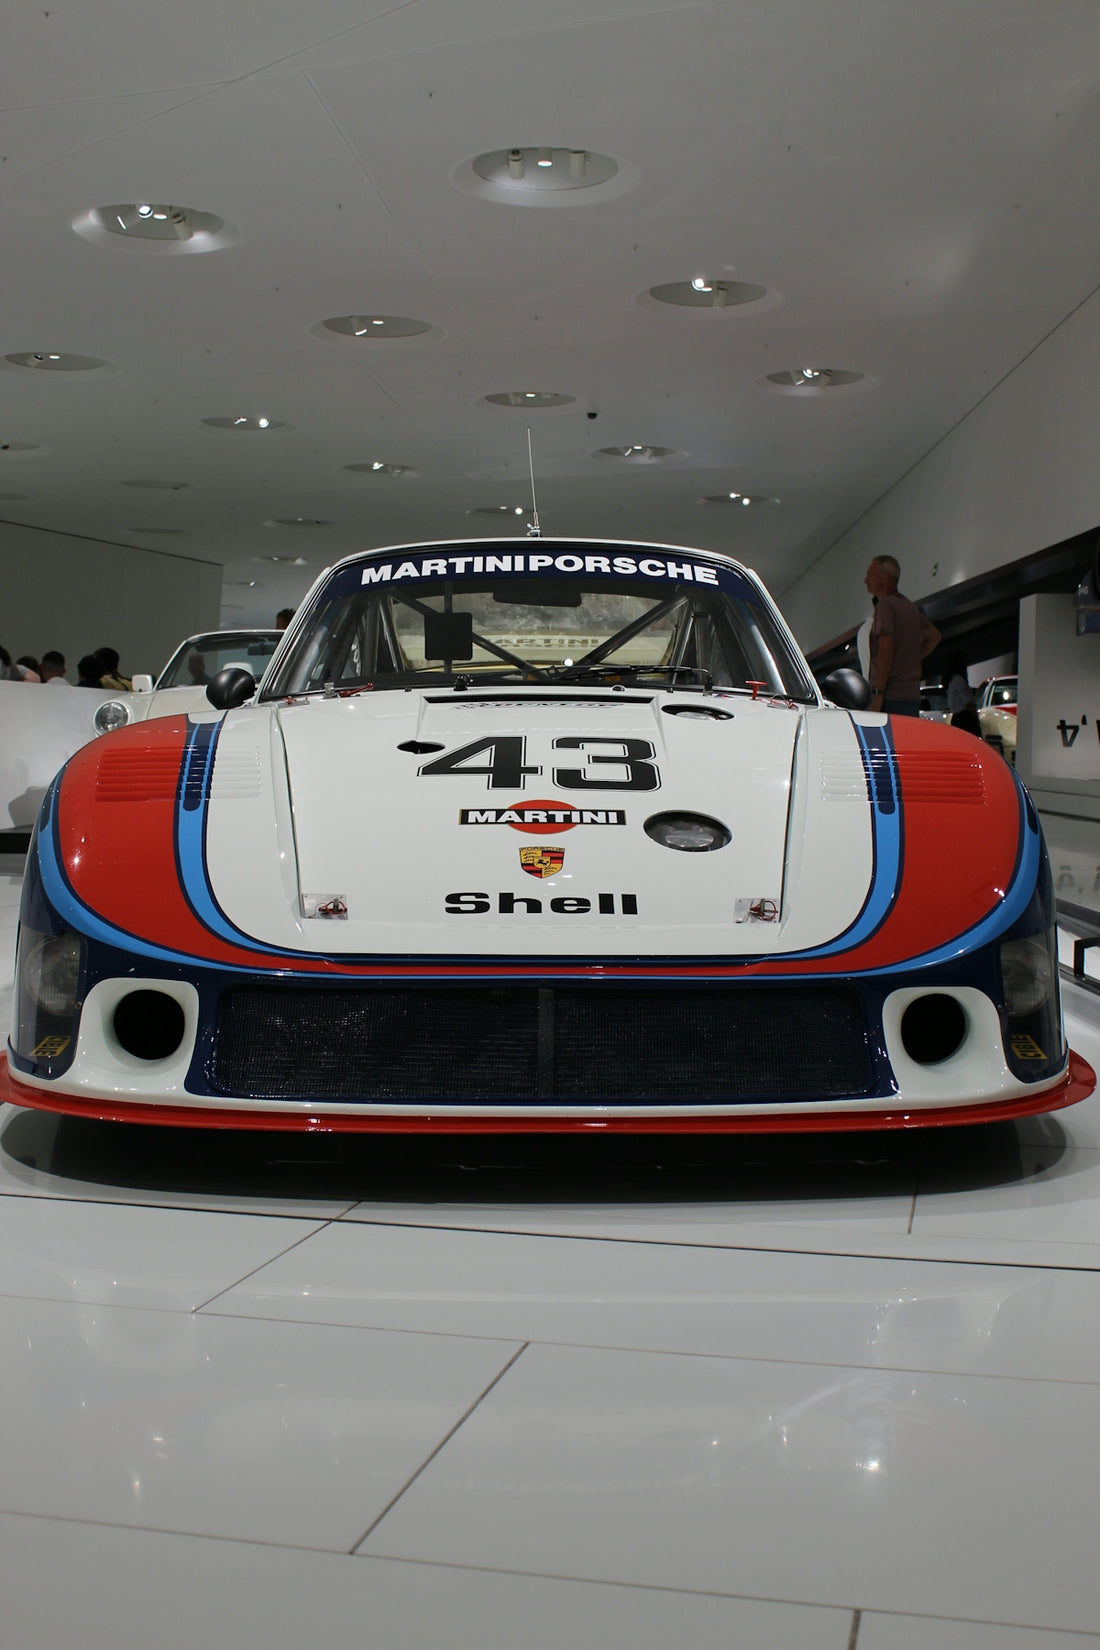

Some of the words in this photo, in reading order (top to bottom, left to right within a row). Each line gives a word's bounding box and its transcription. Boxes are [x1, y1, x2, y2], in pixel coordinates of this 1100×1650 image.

[417, 735, 662, 792] 43
[467, 810, 619, 824] MARTINI
[445, 892, 638, 915] Shell
